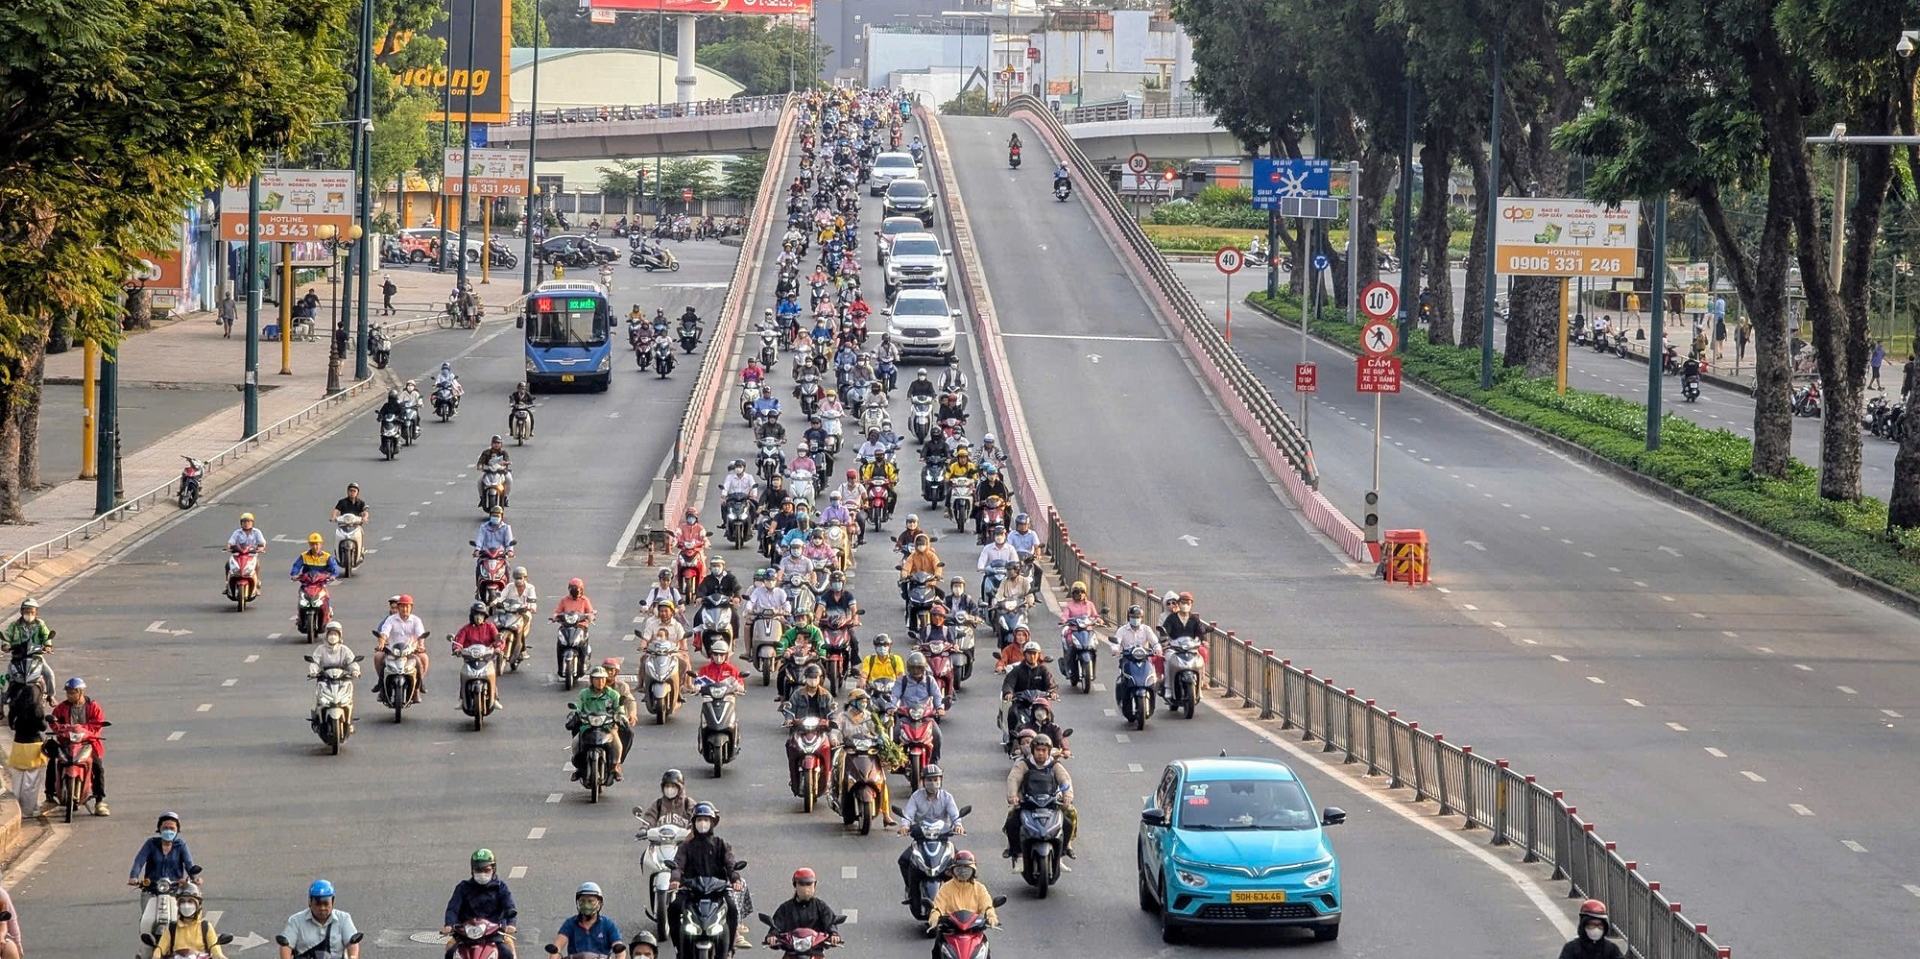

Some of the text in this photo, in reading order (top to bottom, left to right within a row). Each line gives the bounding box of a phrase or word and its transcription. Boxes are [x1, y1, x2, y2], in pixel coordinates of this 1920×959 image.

[1134, 159, 1143, 168] 30
[481, 184, 498, 193] 331
[503, 185, 520, 194] 246
[280, 224, 309, 237] 343
[1547, 249, 1583, 257] HOTLINE:
[1223, 254, 1234, 266] 40
[1510, 256, 1620, 272] 0906 331 246
[1368, 356, 1391, 367] CẤM
[1379, 375, 1395, 383] BÁNH
[1377, 383, 1396, 391] THÔNG
